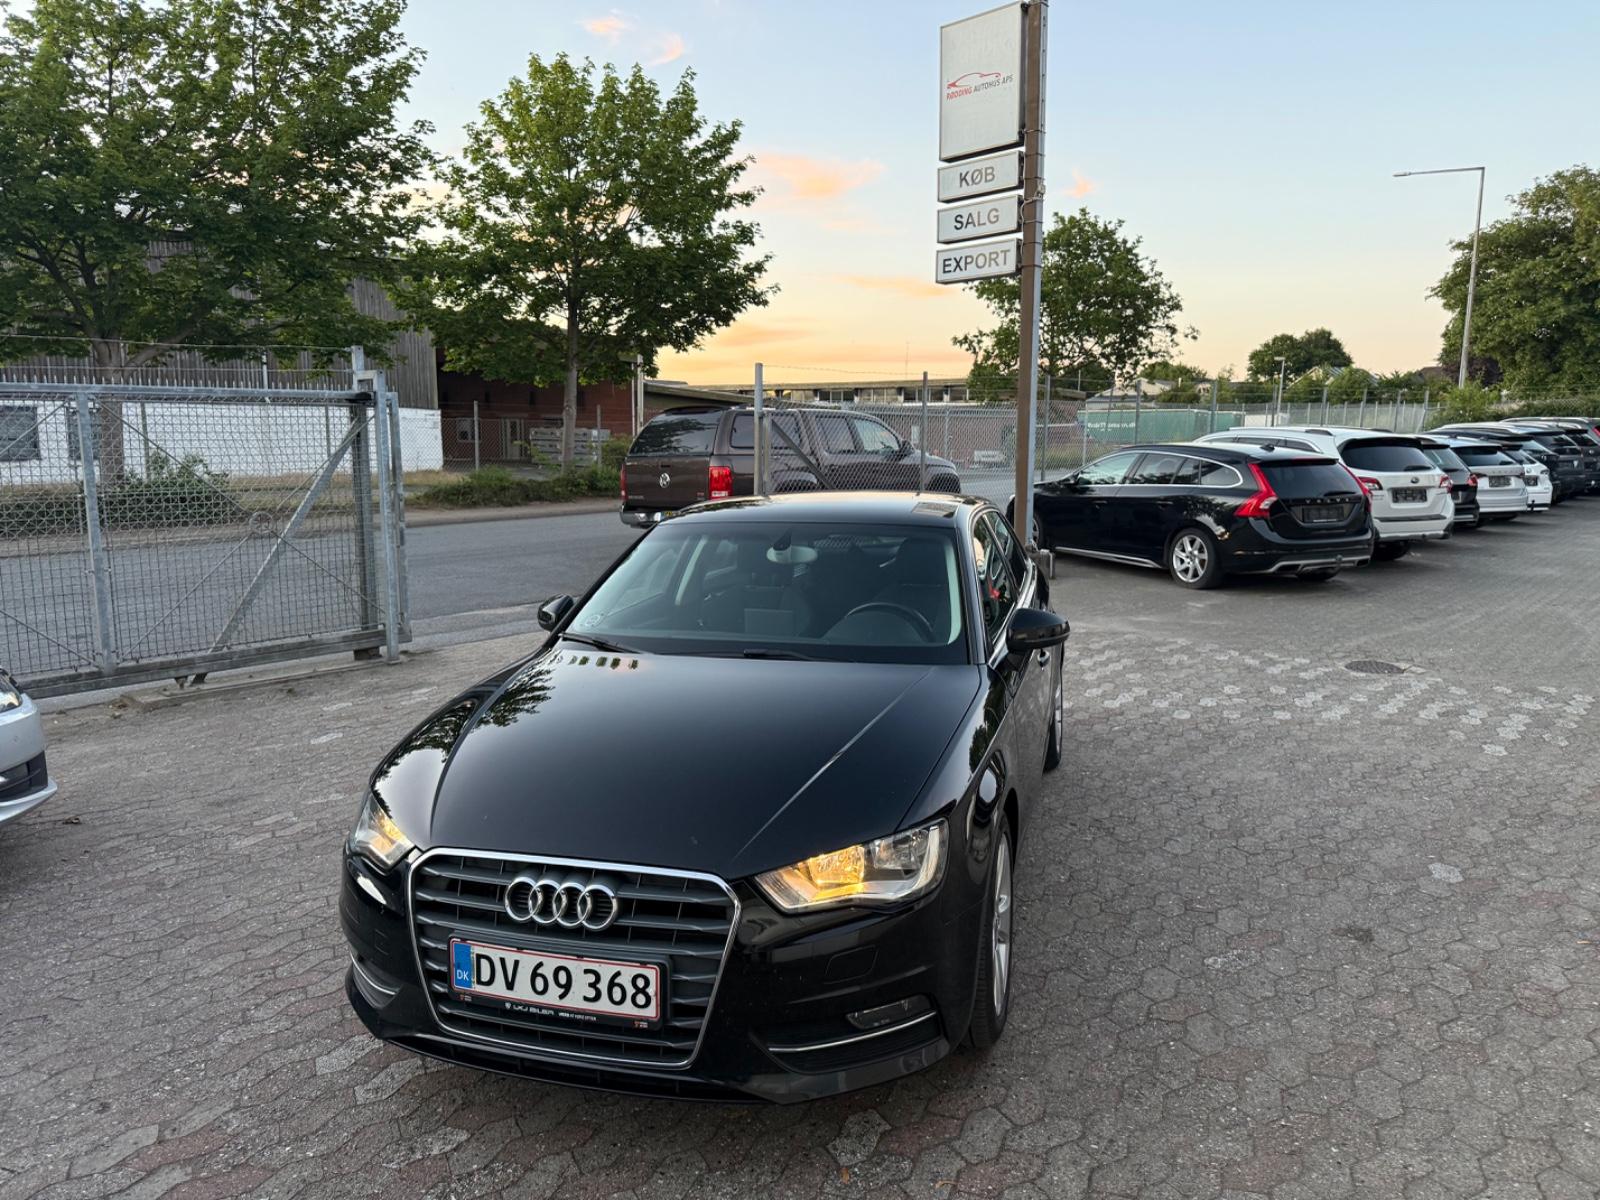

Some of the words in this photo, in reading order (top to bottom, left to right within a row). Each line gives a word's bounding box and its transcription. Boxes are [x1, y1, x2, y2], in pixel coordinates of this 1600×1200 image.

[959, 166, 996, 188] KØB
[953, 208, 1000, 231] SALG
[942, 249, 1011, 274] EXPORT
[456, 970, 469, 981] DK
[475, 953, 520, 991] DV
[530, 961, 572, 1000] 69
[583, 968, 652, 1009] 368
